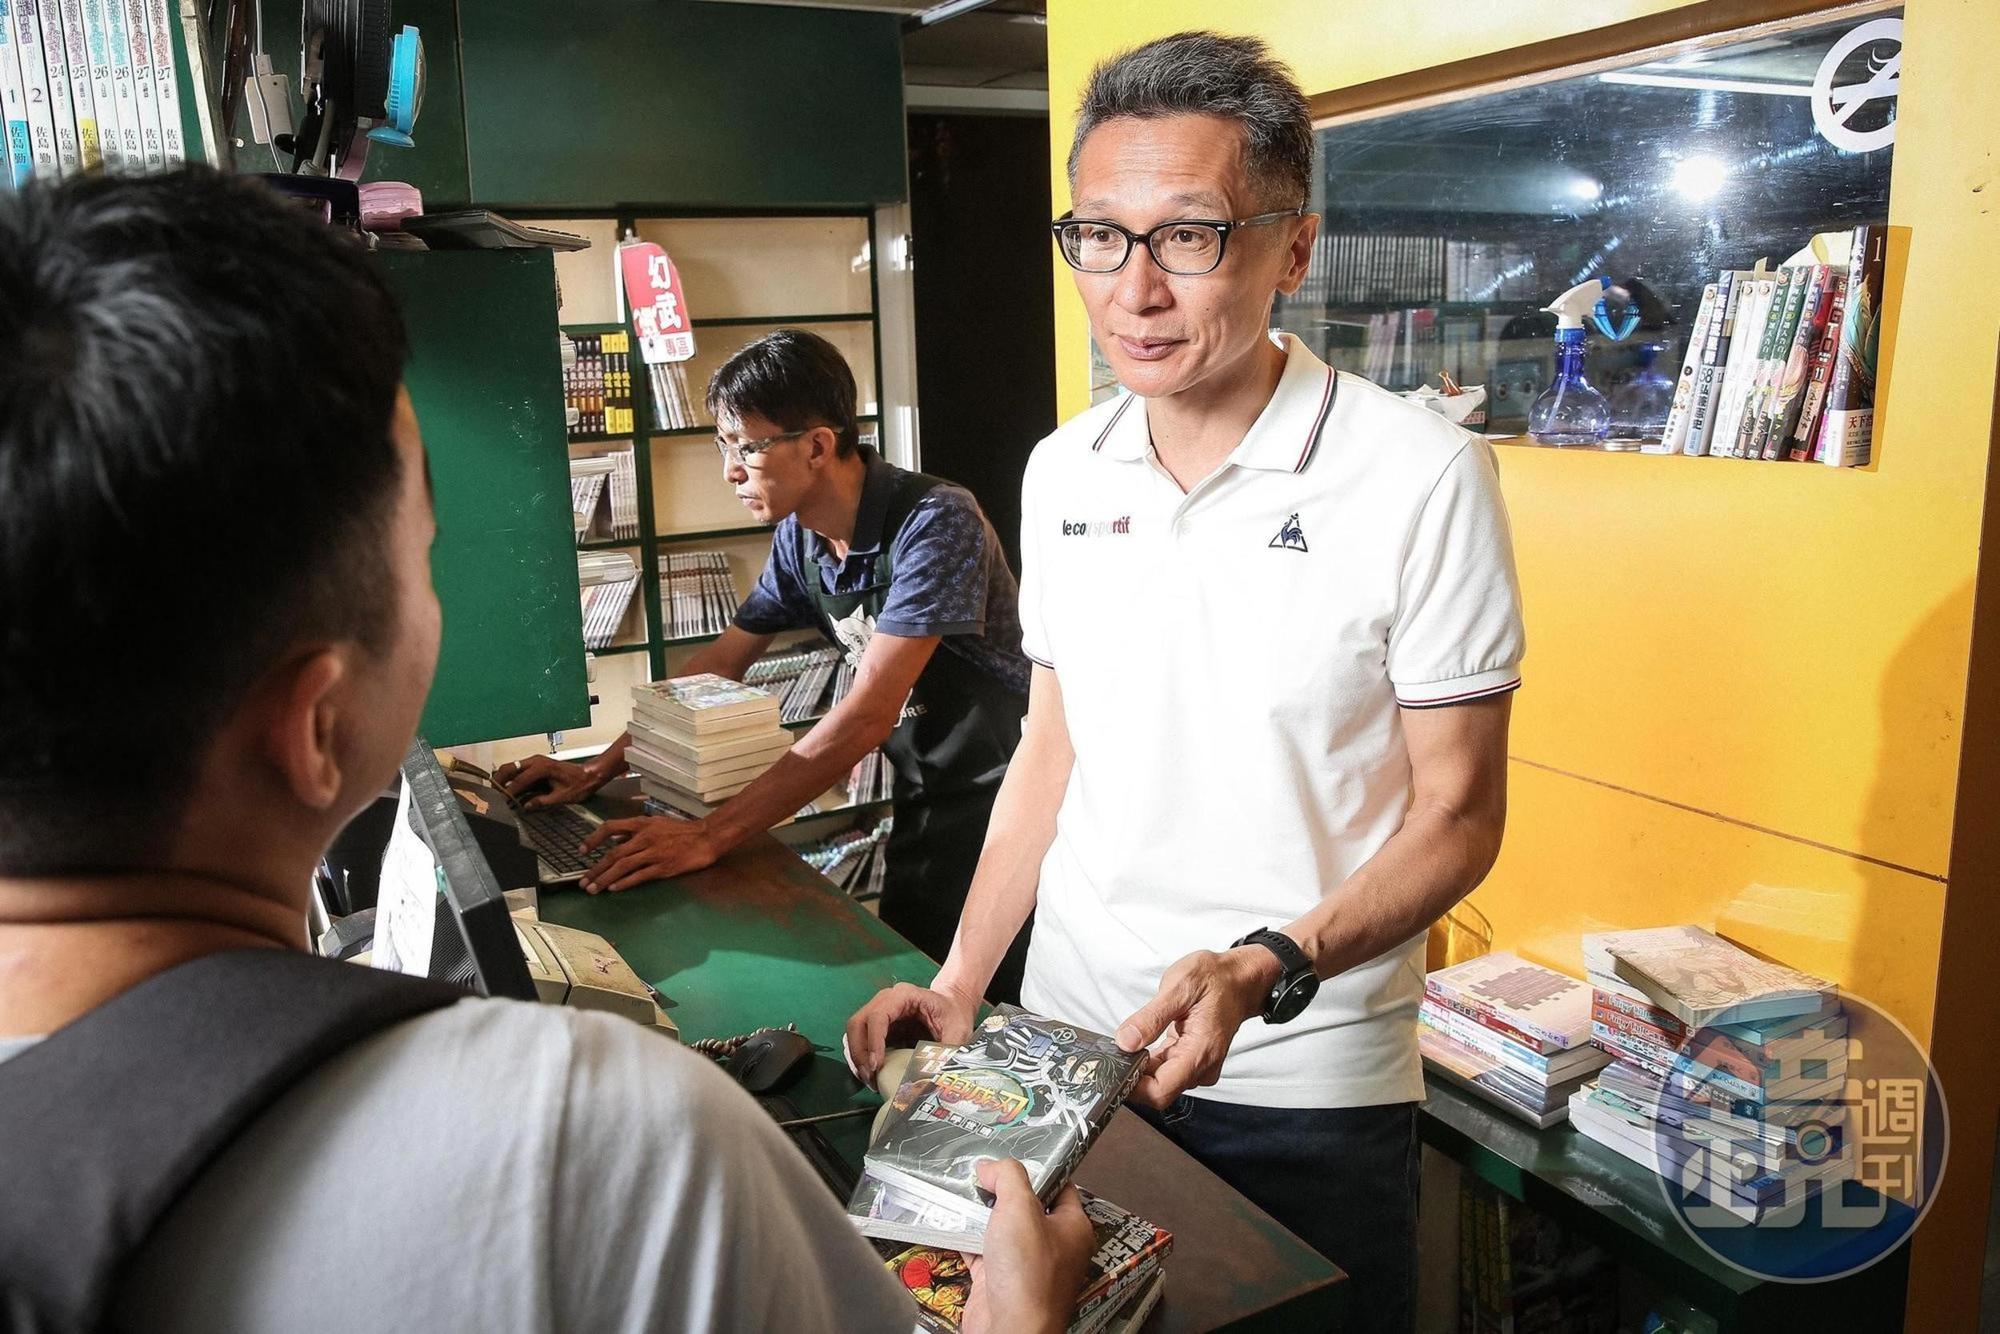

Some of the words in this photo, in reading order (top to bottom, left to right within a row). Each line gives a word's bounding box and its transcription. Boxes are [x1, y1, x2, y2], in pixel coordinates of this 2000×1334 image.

[50, 65, 65, 78] 24
[72, 65, 87, 79] 25
[94, 65, 109, 80] 26
[115, 66, 130, 80] 26
[136, 66, 150, 80] 27
[157, 67, 171, 80] 27
[10, 89, 15, 103] 1
[31, 87, 43, 103] 2
[1873, 236, 1882, 262] 1
[1056, 1028, 1073, 1042] 19
